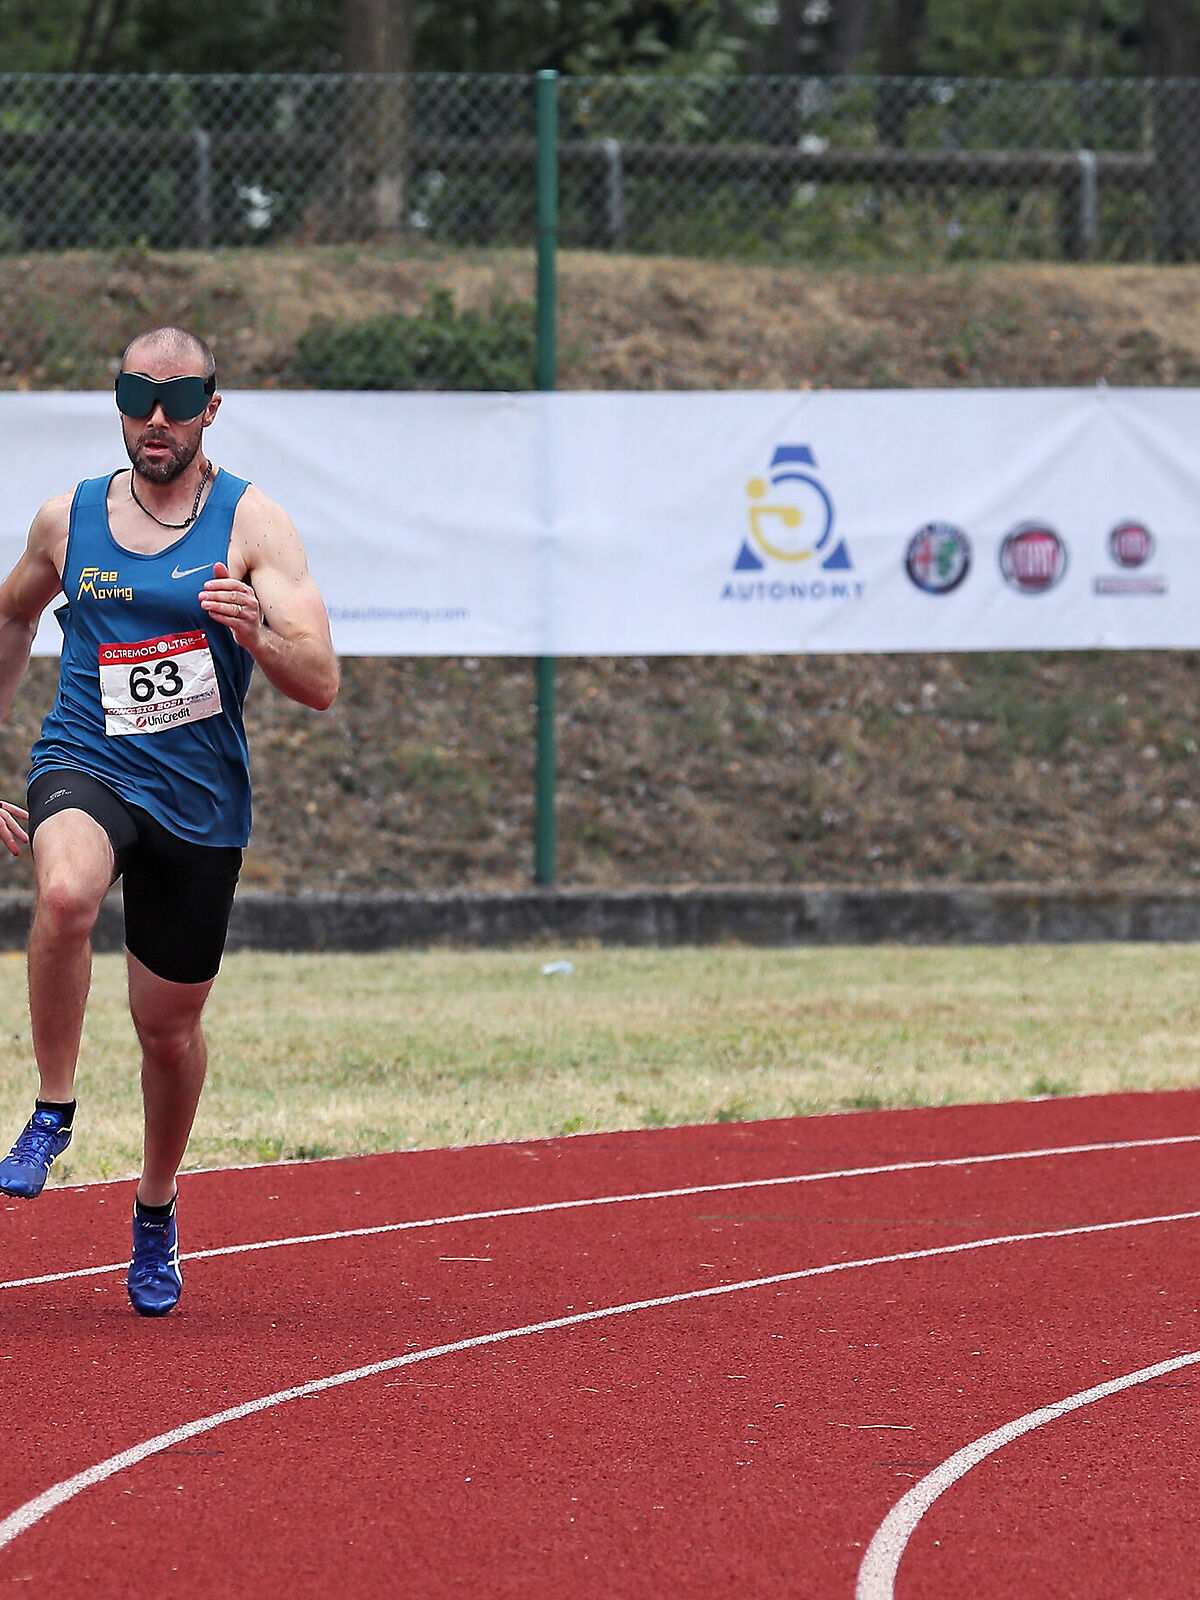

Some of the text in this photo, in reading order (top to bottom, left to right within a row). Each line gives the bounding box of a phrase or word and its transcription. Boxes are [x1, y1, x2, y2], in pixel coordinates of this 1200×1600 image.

[78, 567, 119, 583] Free
[77, 581, 133, 601] Moving
[721, 581, 866, 600] AUTONOMY
[129, 660, 184, 703] 63
[147, 707, 191, 727] UniCredit
